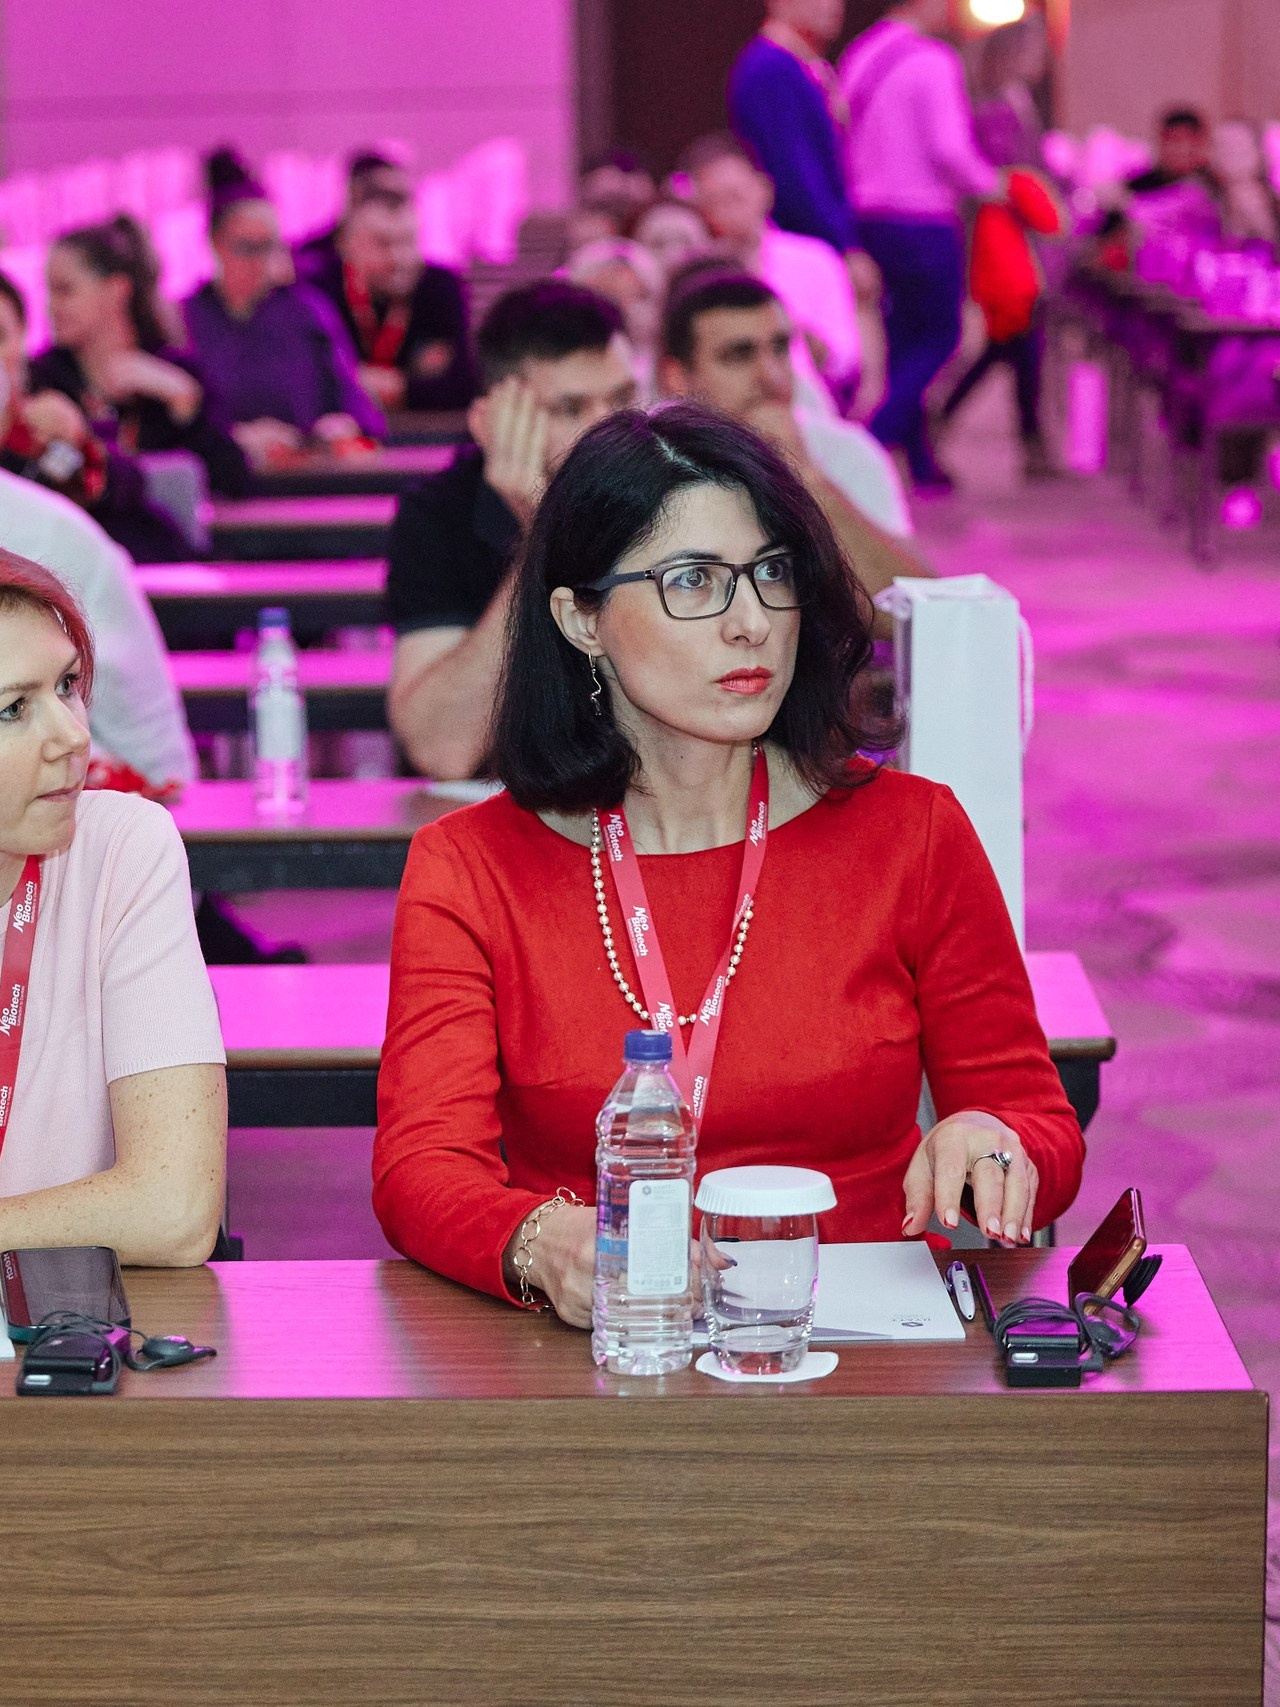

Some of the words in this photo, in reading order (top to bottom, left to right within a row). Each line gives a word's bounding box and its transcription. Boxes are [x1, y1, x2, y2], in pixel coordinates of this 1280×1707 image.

[609, 813, 624, 837] Neo
[749, 820, 759, 847] Neo
[756, 801, 765, 839] Biotech
[608, 824, 623, 861] Biotech
[21, 881, 33, 923] Biotech
[13, 904, 24, 933] Neo
[633, 905, 649, 931] Neo
[631, 917, 648, 956] Biotech
[8, 984, 21, 1026] Biotech
[708, 975, 723, 1016] Biotech
[0, 1007, 11, 1036] Neo
[657, 1001, 673, 1028] Neo
[700, 998, 711, 1026] Neo
